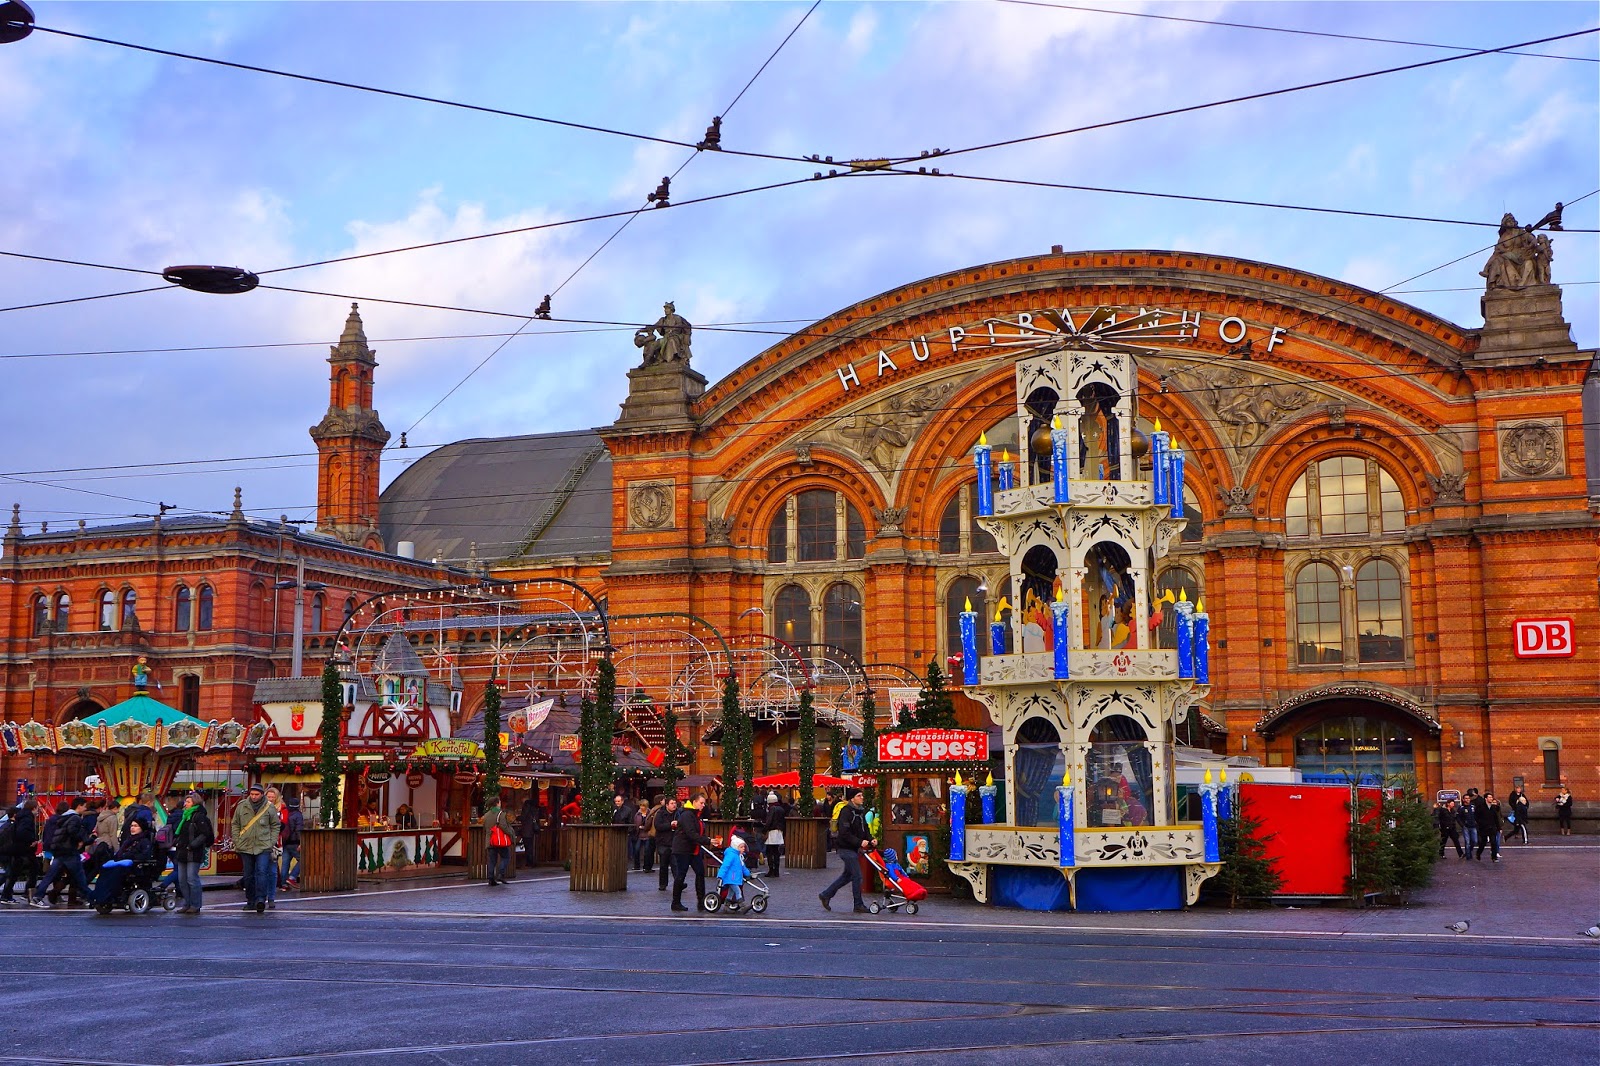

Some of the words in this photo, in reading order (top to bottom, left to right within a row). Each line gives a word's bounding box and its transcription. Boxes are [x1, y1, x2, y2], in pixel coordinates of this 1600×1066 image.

[1521, 624, 1567, 651] DB
[906, 732, 965, 740] Französische
[886, 738, 977, 760] Crêpes
[858, 776, 878, 786] Crêp
